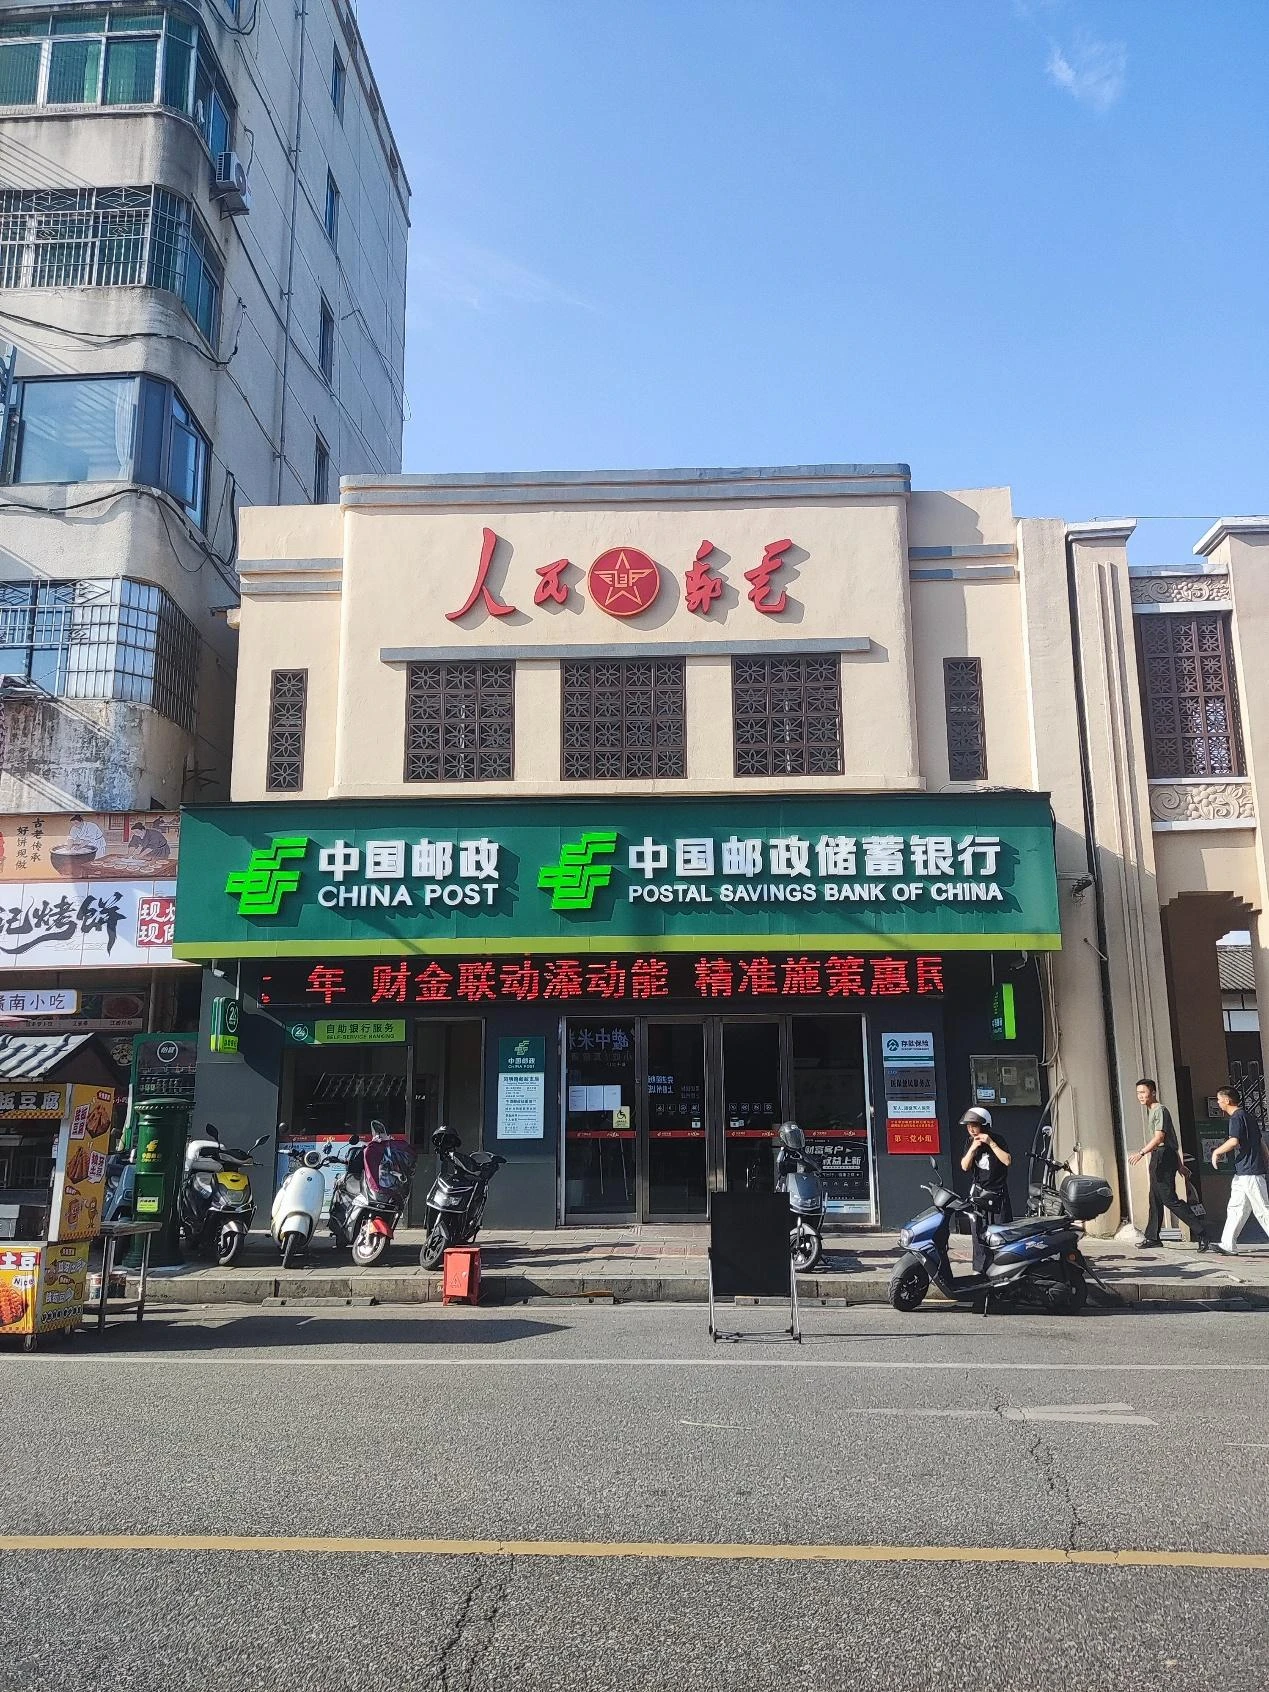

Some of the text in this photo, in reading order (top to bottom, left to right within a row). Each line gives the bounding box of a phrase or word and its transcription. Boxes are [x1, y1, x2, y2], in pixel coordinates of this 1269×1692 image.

[15, 826, 30, 870] 好饼现做
[30, 816, 45, 863] 古老传承
[318, 837, 499, 881] 中国邮政
[628, 834, 1001, 879] 中国邮政储蓄银行
[317, 883, 499, 908] CHINA POST
[628, 882, 1004, 903] POSTAL SAVINGS BANK OF CHINA
[306, 955, 944, 1004] 年 财金联动添动能 精准施策惠民
[326, 1022, 394, 1034] 自助银行服务
[508, 1057, 536, 1065] 中国邮政
